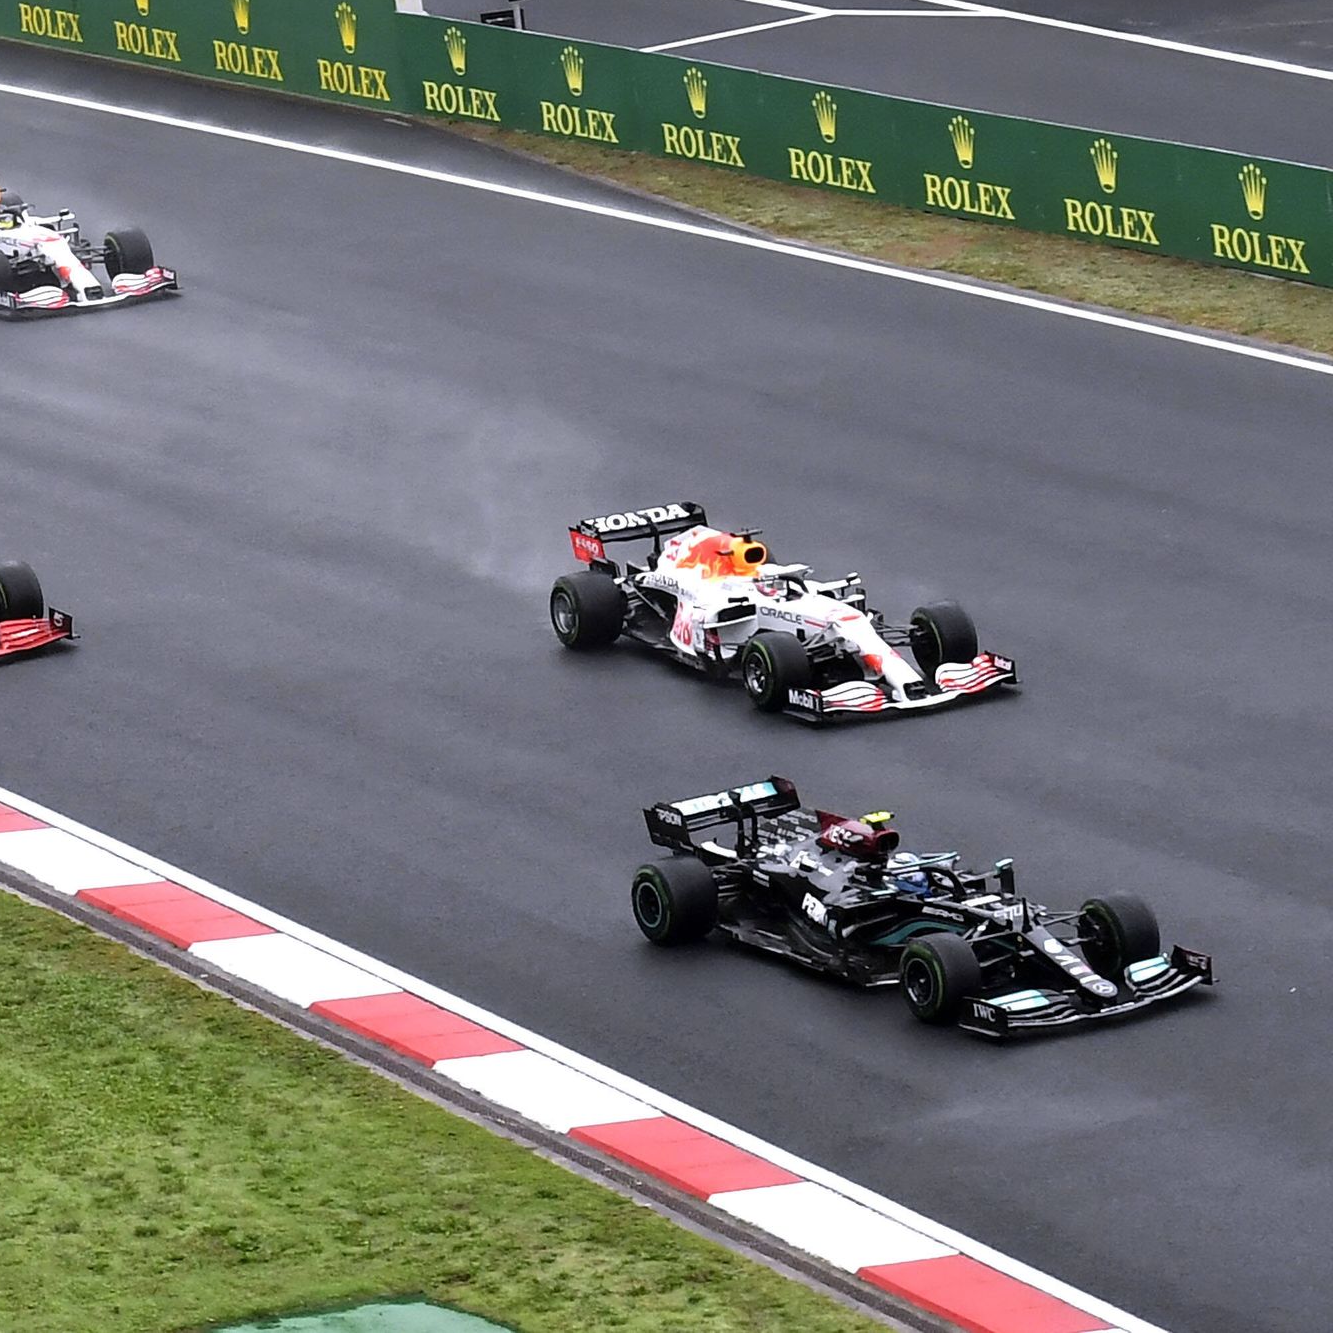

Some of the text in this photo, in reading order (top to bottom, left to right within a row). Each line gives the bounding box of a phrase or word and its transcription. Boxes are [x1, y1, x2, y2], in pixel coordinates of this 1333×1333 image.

[18, 2, 83, 43] ROLEX
[115, 21, 181, 62] ROLEX
[213, 40, 283, 82] ROLEX
[317, 59, 390, 101] ROLEX
[423, 81, 501, 122] ROLEX
[540, 101, 619, 144] ROLEX
[661, 123, 745, 167] ROLEX
[788, 147, 876, 194] ROLEX
[924, 173, 1015, 221] ROLEX
[1064, 198, 1160, 246] ROLEX
[1211, 224, 1310, 274] ROLEX
[584, 503, 690, 533] HONDA
[760, 606, 803, 625] ORACLE
[788, 688, 813, 709] Mobil
[973, 1003, 996, 1023] IWC
